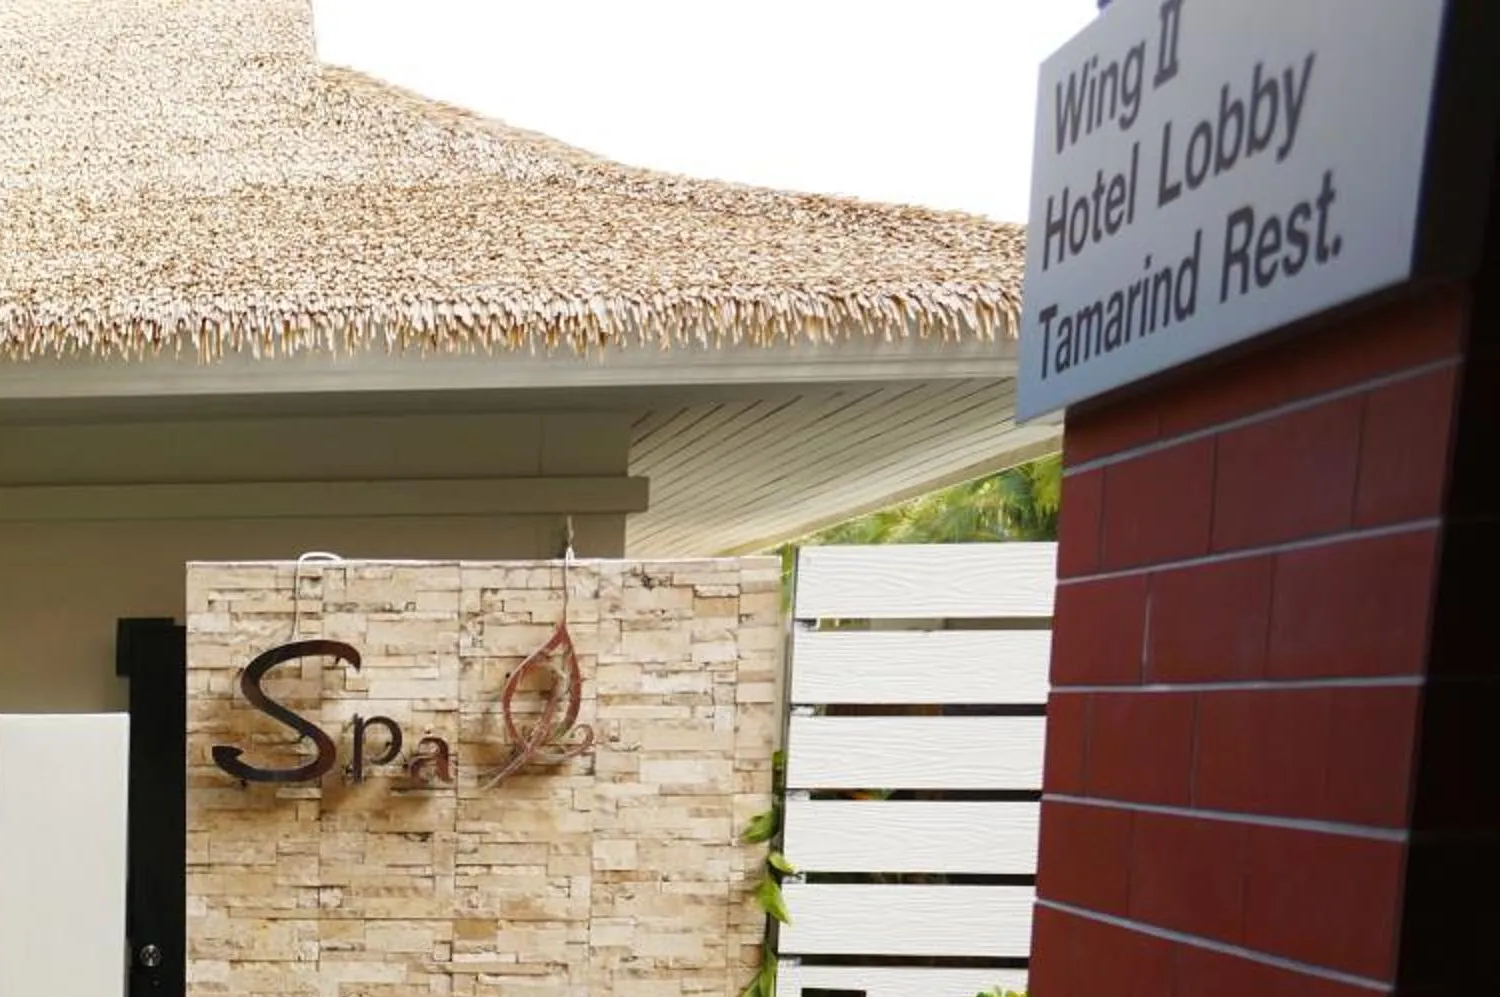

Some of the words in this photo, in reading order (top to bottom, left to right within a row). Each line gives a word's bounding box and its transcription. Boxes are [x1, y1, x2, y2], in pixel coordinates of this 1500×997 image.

[1042, 142, 1140, 272] Hotel
[1158, 51, 1316, 207] Lobby
[1056, 40, 1146, 155] Wing
[1039, 230, 1203, 381] Tamarind
[1220, 169, 1343, 304] Rest.
[211, 639, 455, 784] Spa
